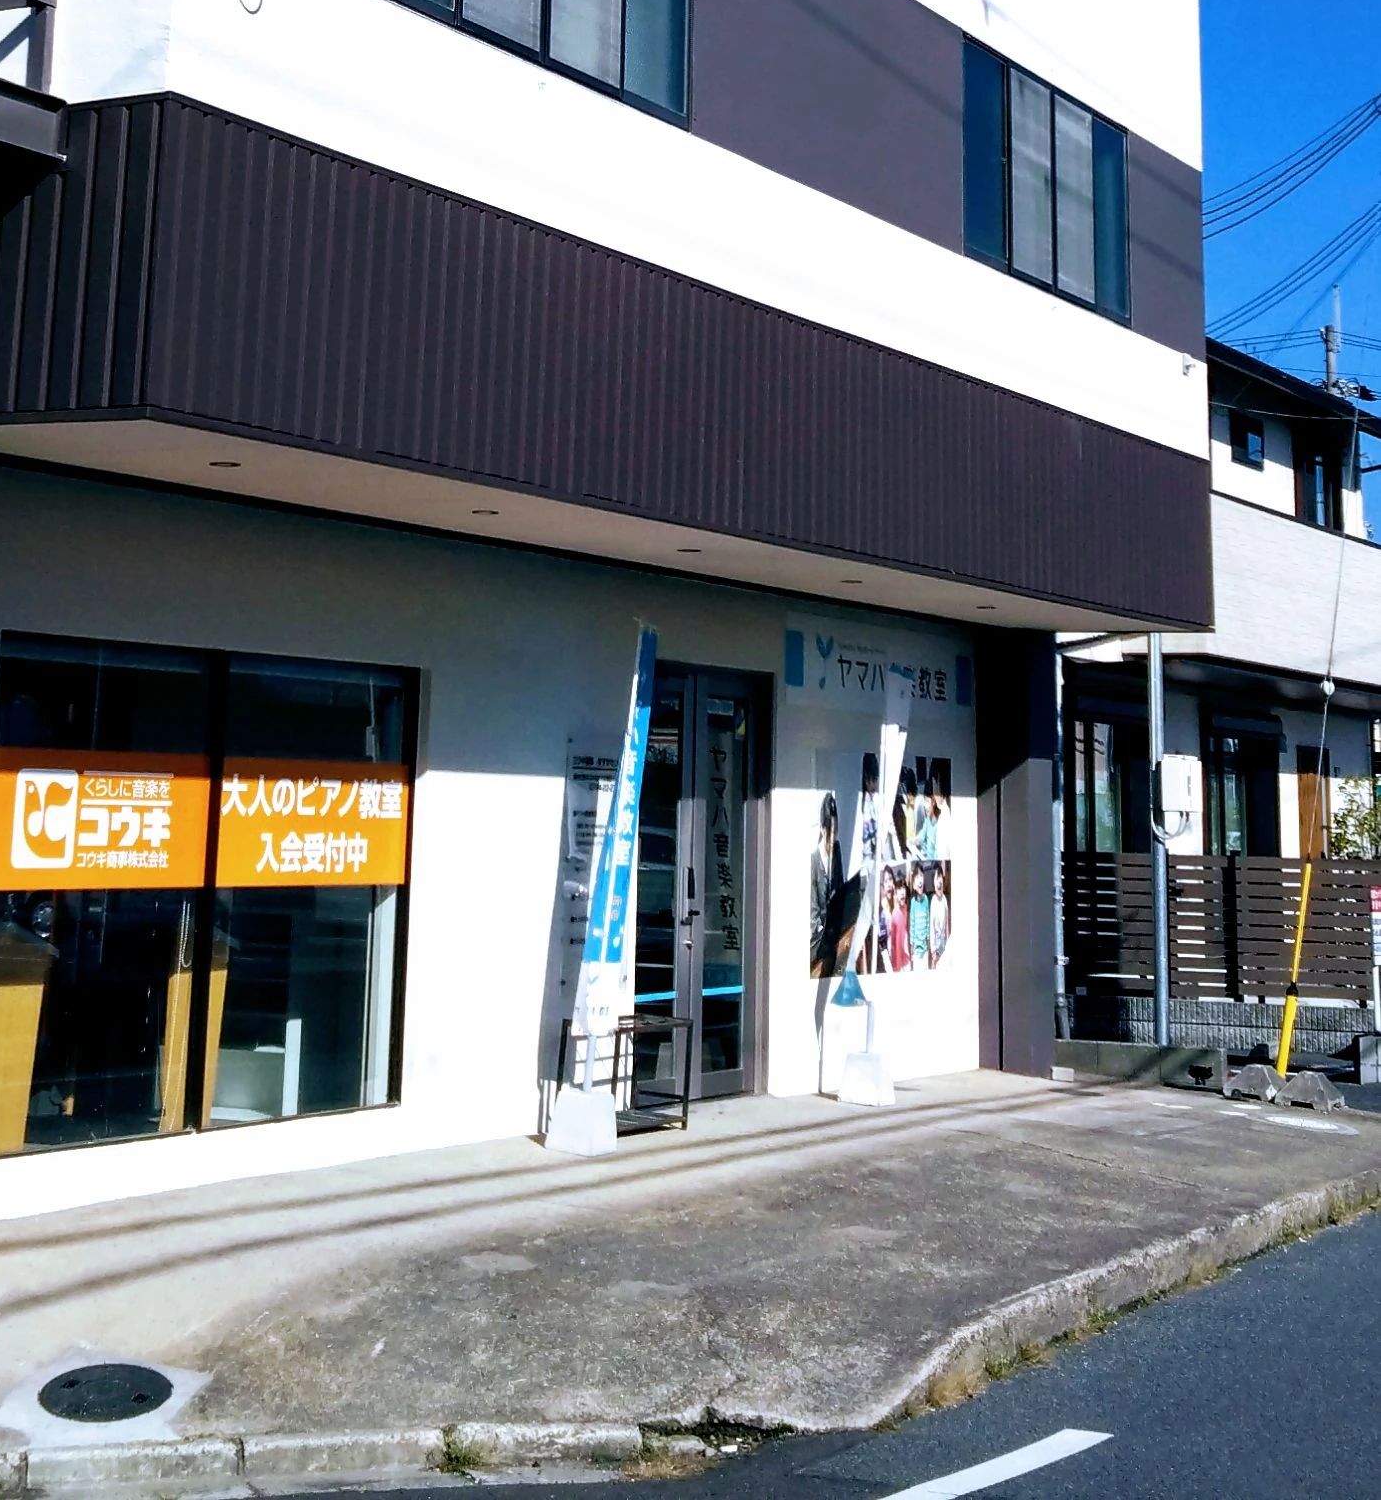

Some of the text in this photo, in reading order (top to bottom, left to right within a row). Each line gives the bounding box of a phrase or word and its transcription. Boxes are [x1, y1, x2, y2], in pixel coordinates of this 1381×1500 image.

[837, 654, 947, 701] ヤマハ教室
[84, 778, 171, 799] くらしに音楽を
[221, 773, 404, 820] 大人のピアノ教室
[77, 806, 171, 848] コウキ
[76, 850, 169, 870] コウキ商事株式会社
[255, 831, 369, 874] 入会受付中
[709, 746, 740, 952] ヤマハ音楽教室
